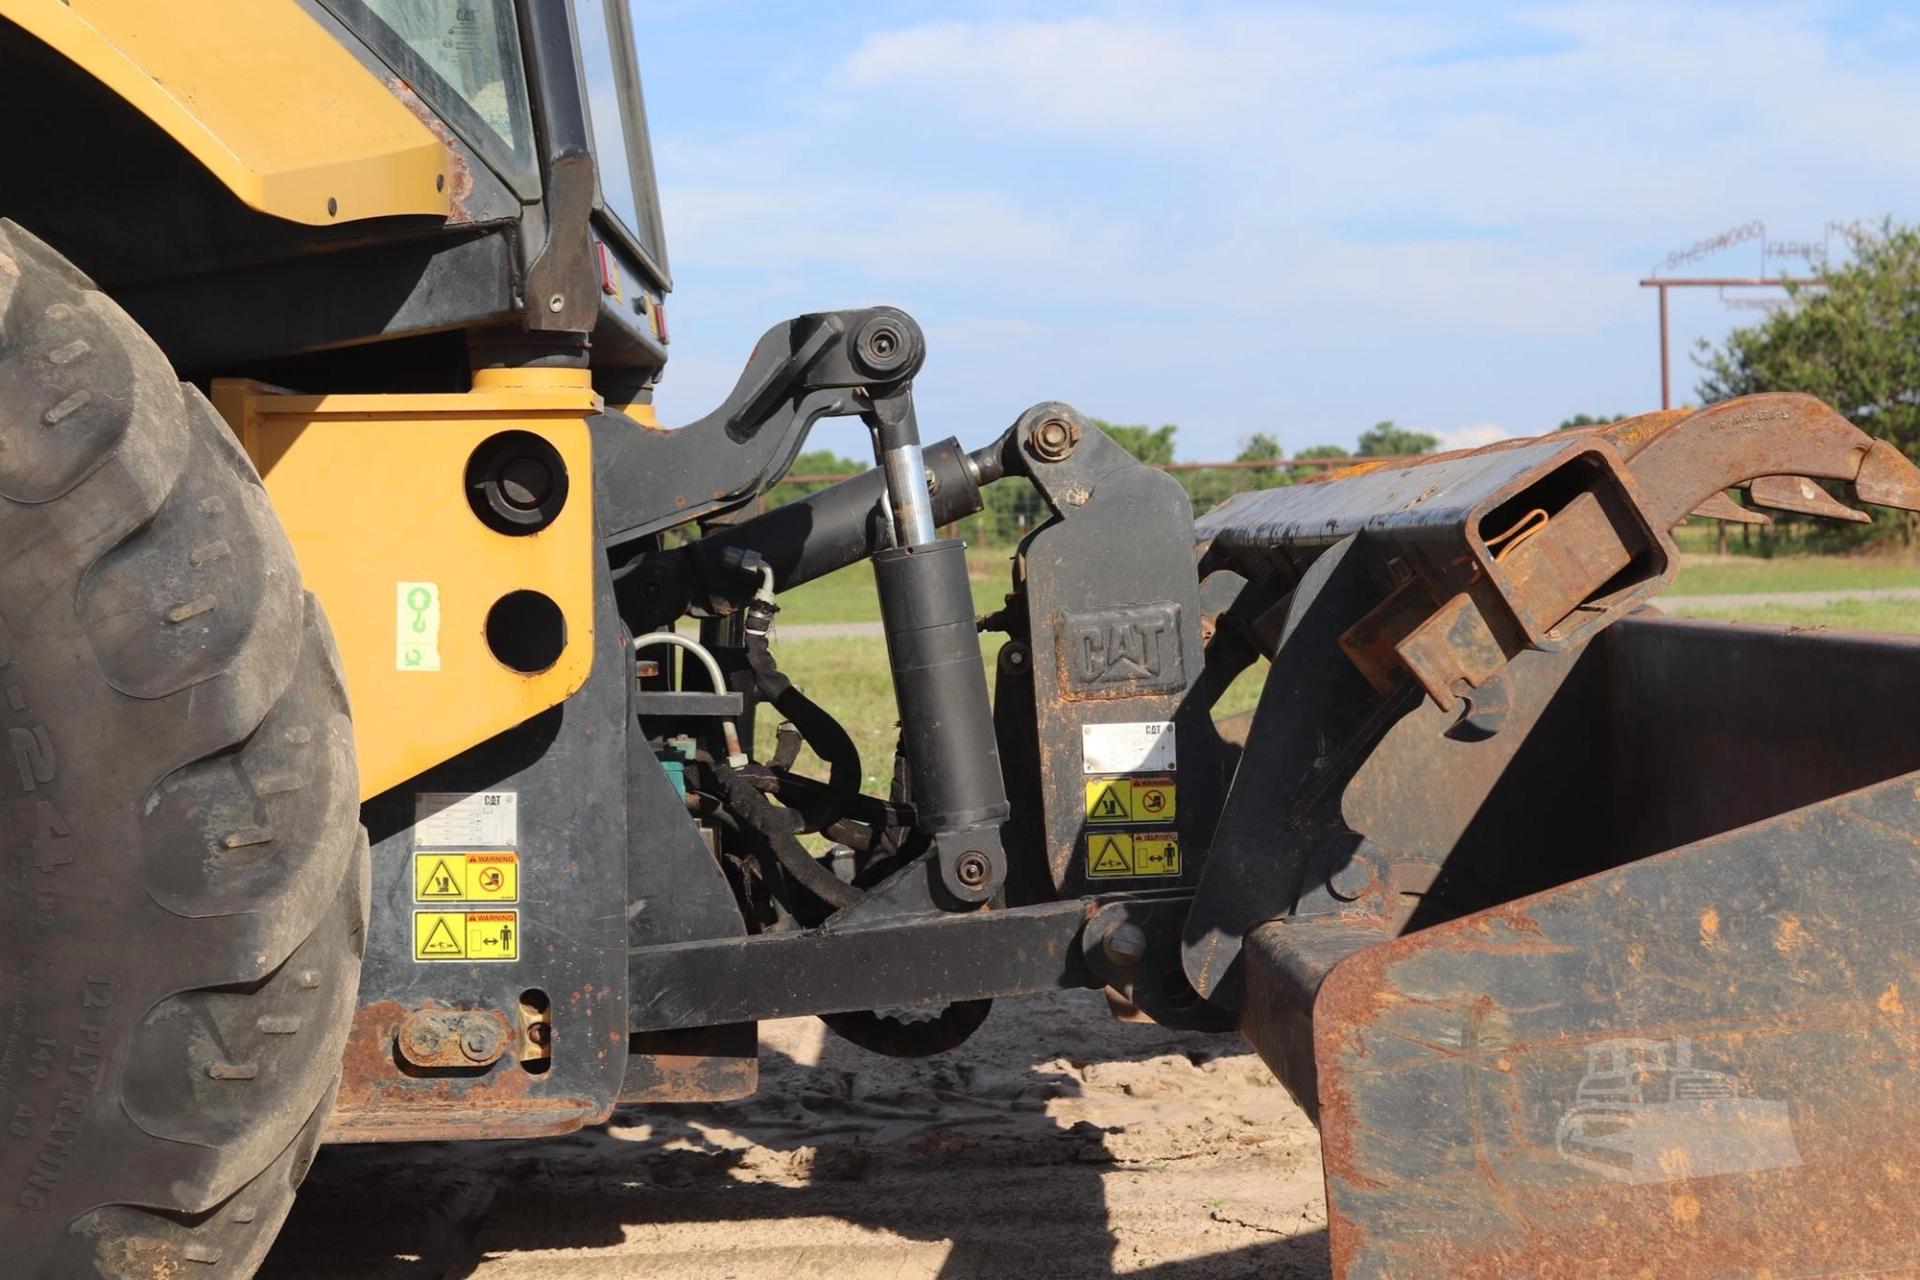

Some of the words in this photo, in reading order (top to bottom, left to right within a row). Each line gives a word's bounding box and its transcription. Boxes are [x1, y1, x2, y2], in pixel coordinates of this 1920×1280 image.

[1077, 621, 1164, 685] CAT
[1146, 725, 1161, 735] CAT
[484, 795, 501, 806] CAT
[478, 855, 514, 864] WARNING
[478, 914, 514, 922] WARNING
[84, 973, 114, 1009] 12
[70, 1023, 107, 1084] PLY
[17, 1091, 90, 1214] RATING
